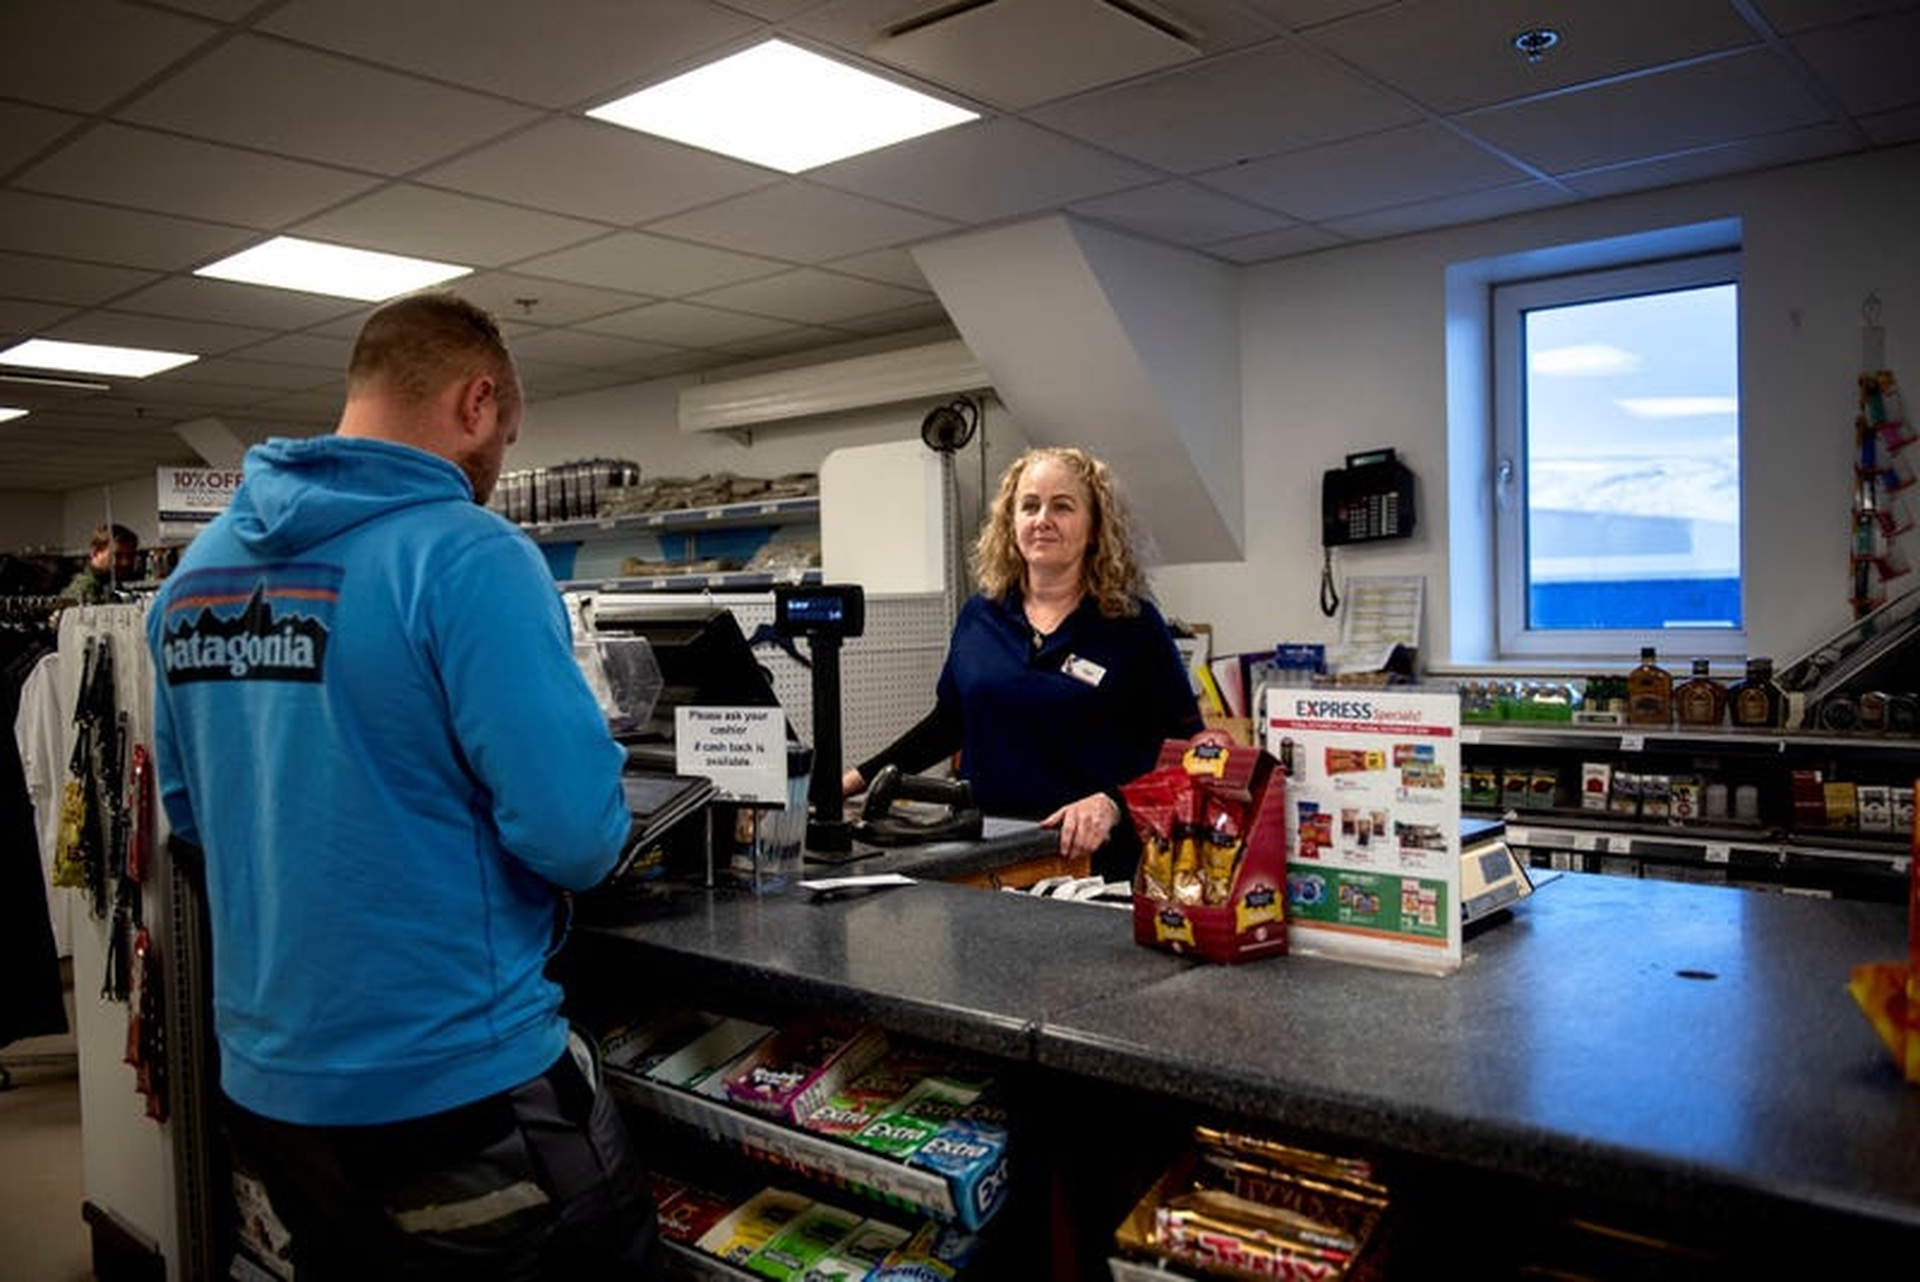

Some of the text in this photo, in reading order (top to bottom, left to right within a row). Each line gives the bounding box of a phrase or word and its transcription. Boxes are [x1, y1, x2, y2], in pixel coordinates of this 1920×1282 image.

[689, 711, 769, 722] Please ask your
[1296, 700, 1372, 719] EXPRESS
[710, 725, 748, 735] cashier
[703, 743, 728, 752] cash
[729, 743, 753, 752] back
[756, 744, 765, 753] is
[808, 1105, 873, 1126] Extra
[862, 1122, 929, 1144] Extra
[919, 1137, 990, 1162] Extra
